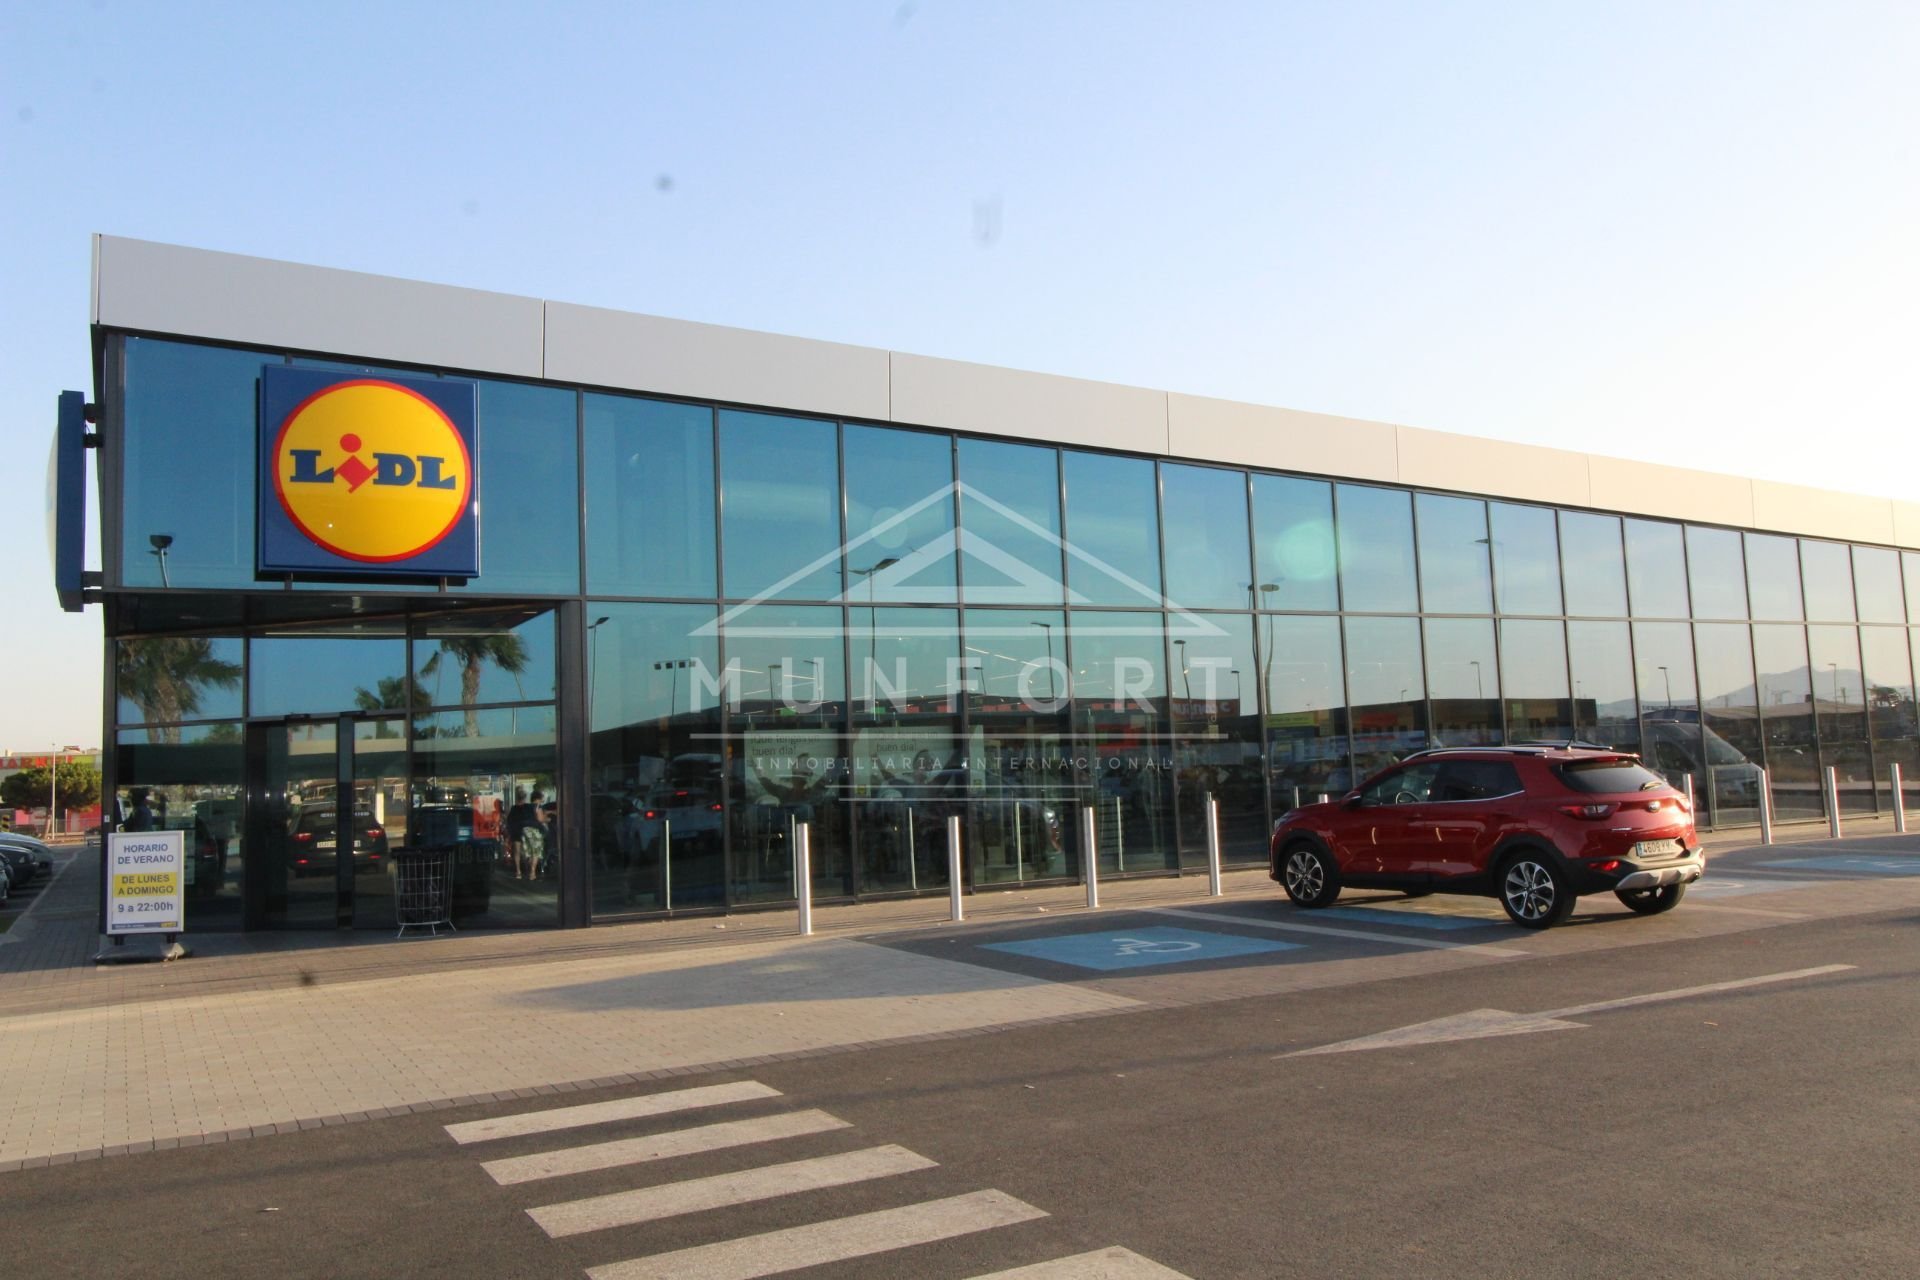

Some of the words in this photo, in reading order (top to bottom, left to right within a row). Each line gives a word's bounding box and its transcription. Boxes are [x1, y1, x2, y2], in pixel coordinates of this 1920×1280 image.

[123, 843, 169, 853] HORARIO
[117, 856, 131, 865] DE
[133, 854, 174, 864] VERANO
[121, 875, 135, 884] DE
[137, 874, 170, 884] LUNES
[118, 886, 125, 895] A
[127, 885, 174, 895] DOMINGO
[118, 903, 124, 913] 9
[137, 902, 174, 912] 22:00h
